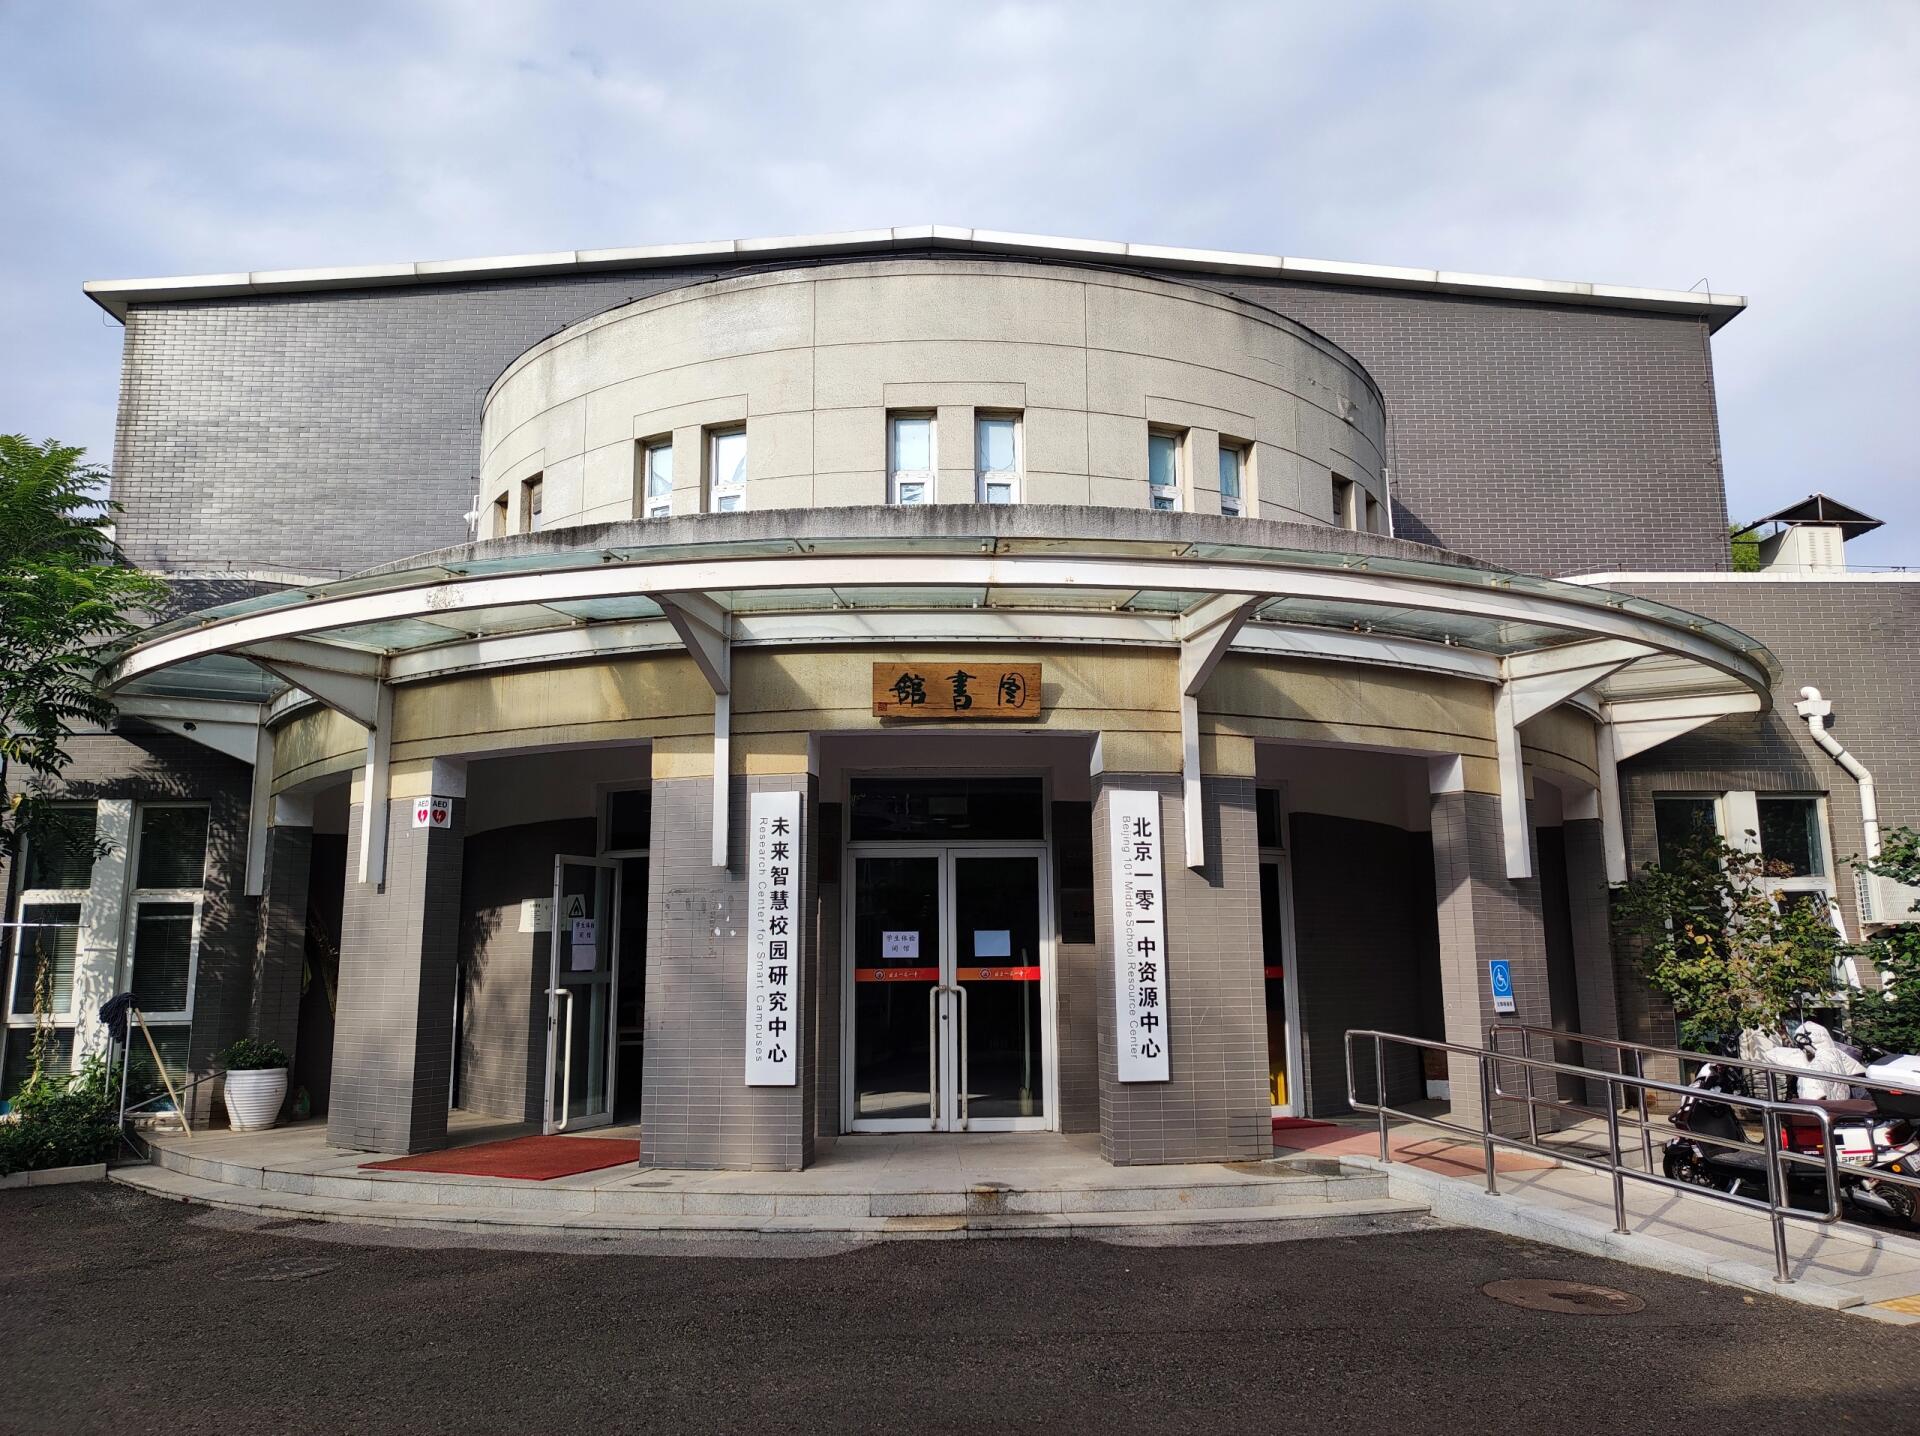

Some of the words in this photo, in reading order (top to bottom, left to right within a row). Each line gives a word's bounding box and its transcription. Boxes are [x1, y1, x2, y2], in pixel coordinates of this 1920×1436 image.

[433, 800, 448, 808] AED
[758, 817, 769, 876] Research
[1120, 815, 1131, 853] Beijing
[1123, 858, 1133, 876] 101
[757, 881, 767, 923] Center
[756, 928, 766, 946] for
[768, 816, 790, 1063] 未来智慧校园研究中心
[1132, 816, 1161, 1059] 北京一零一中资源中心
[756, 951, 766, 989] Smart
[1127, 962, 1137, 1016] Resource
[754, 994, 766, 1062] Campuses
[1129, 1020, 1139, 1059] Center
